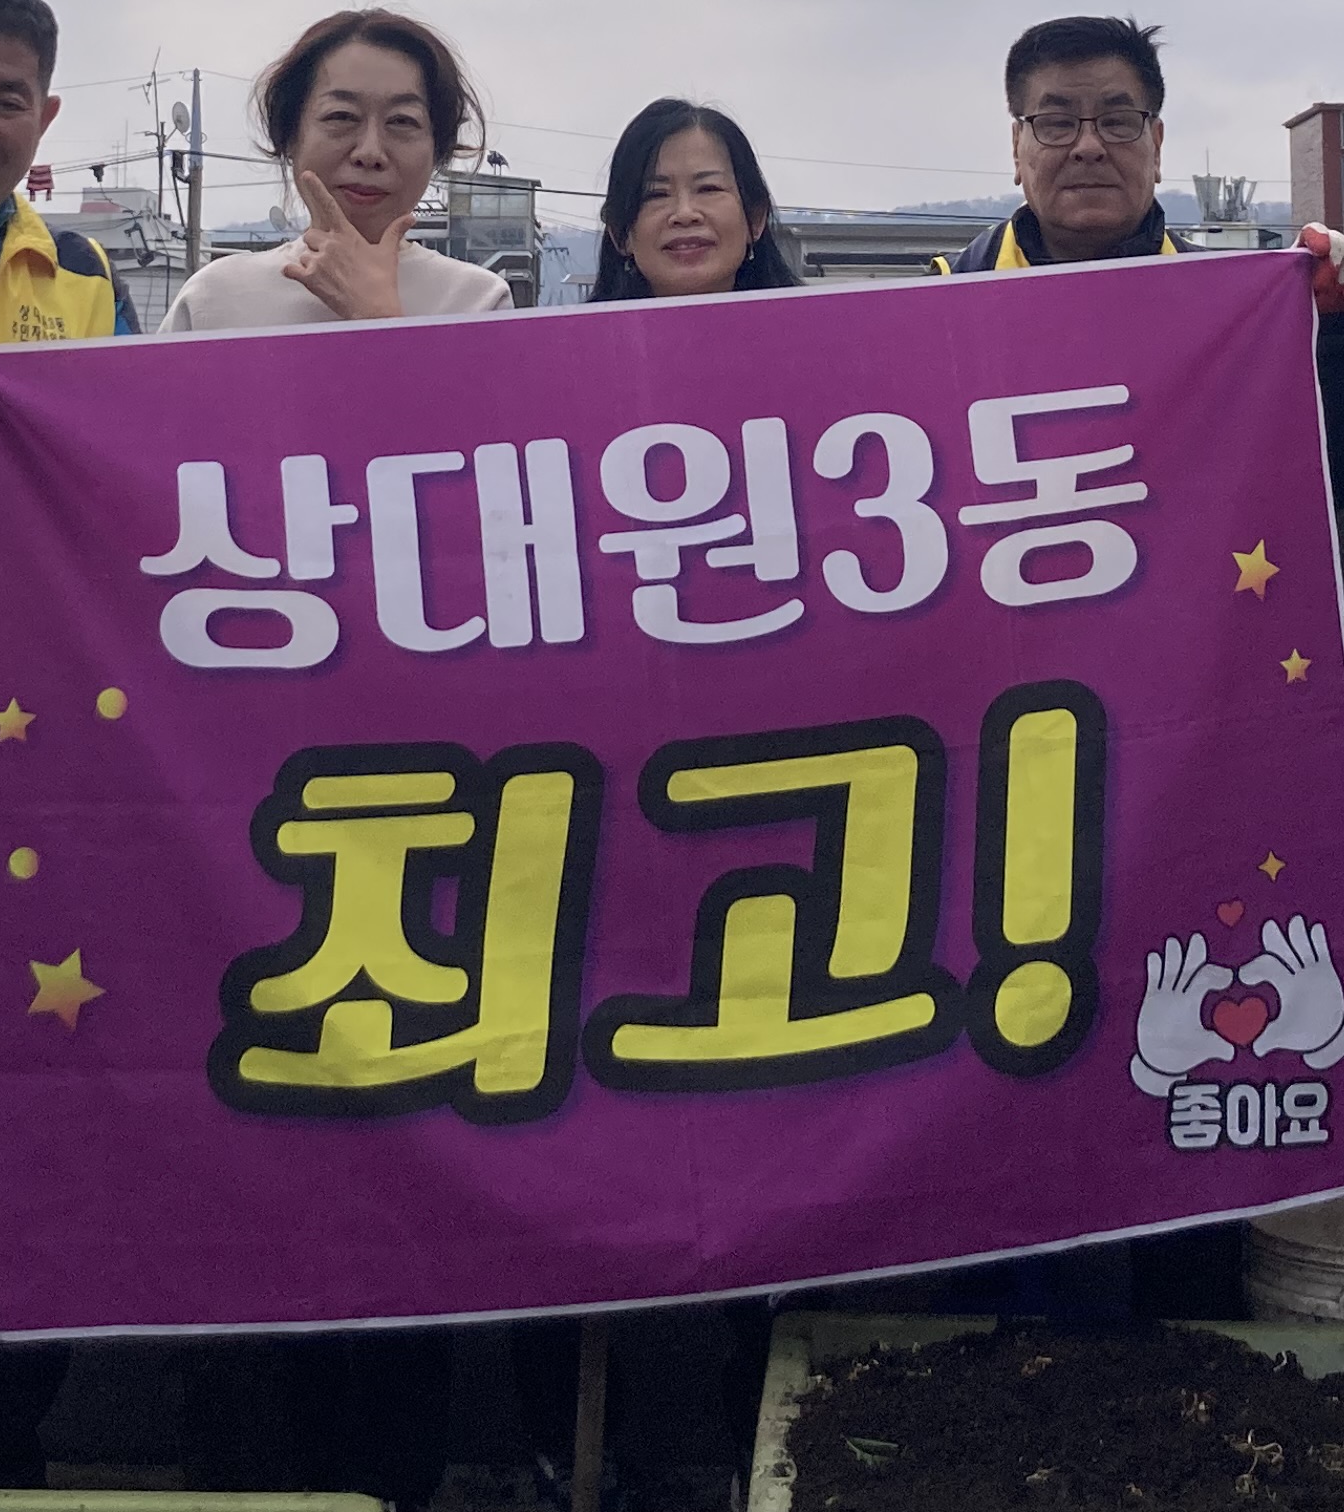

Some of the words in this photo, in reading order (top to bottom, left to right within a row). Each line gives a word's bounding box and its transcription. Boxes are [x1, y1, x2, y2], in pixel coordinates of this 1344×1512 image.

[139, 384, 1148, 668] 상대원3동
[231, 700, 1086, 1100] 최고!
[1170, 1082, 1329, 1148] 좋아요
